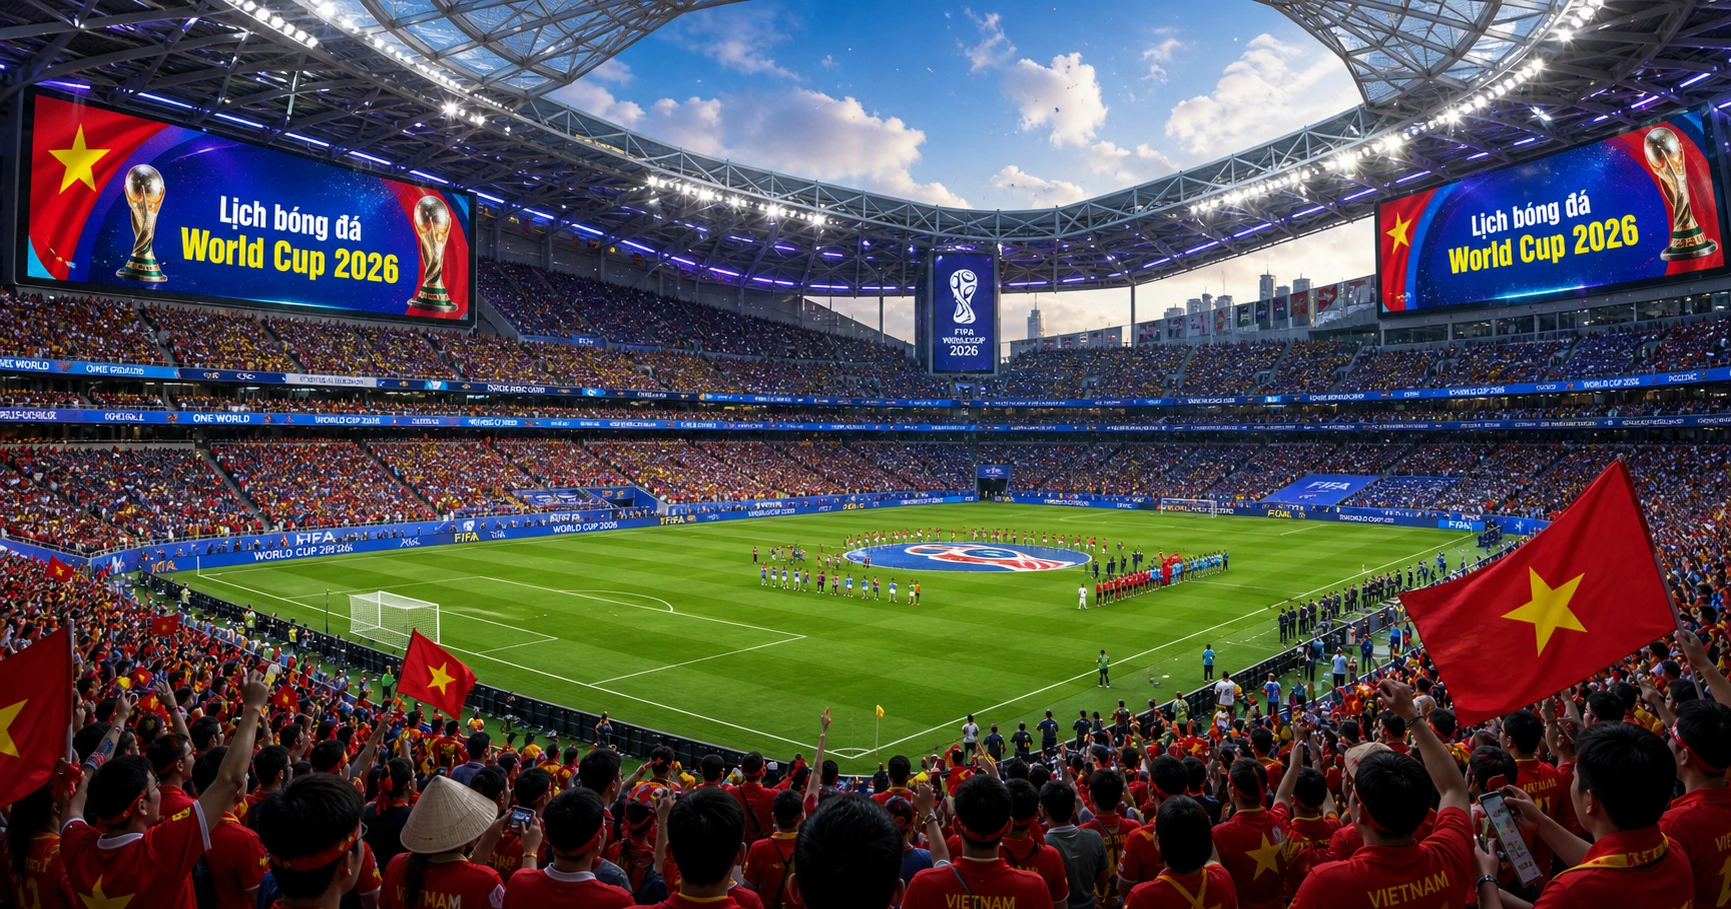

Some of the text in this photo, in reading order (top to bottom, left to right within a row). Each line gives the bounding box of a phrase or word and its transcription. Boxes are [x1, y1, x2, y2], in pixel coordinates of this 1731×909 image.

[219, 195, 362, 242] Lịch bóng đá
[1471, 189, 1591, 242] Lịch bóng đá
[181, 226, 399, 284] World Cup 2026
[1448, 215, 1639, 275] World Cup 2026
[950, 345, 979, 356] 2026
[193, 413, 250, 423] ONE WORLD
[454, 531, 480, 544] FIFA
[254, 549, 293, 561] WORLD
[296, 546, 317, 557] CUP
[945, 893, 1016, 909] VIETNAM
[1367, 870, 1450, 909] VIETNAM
